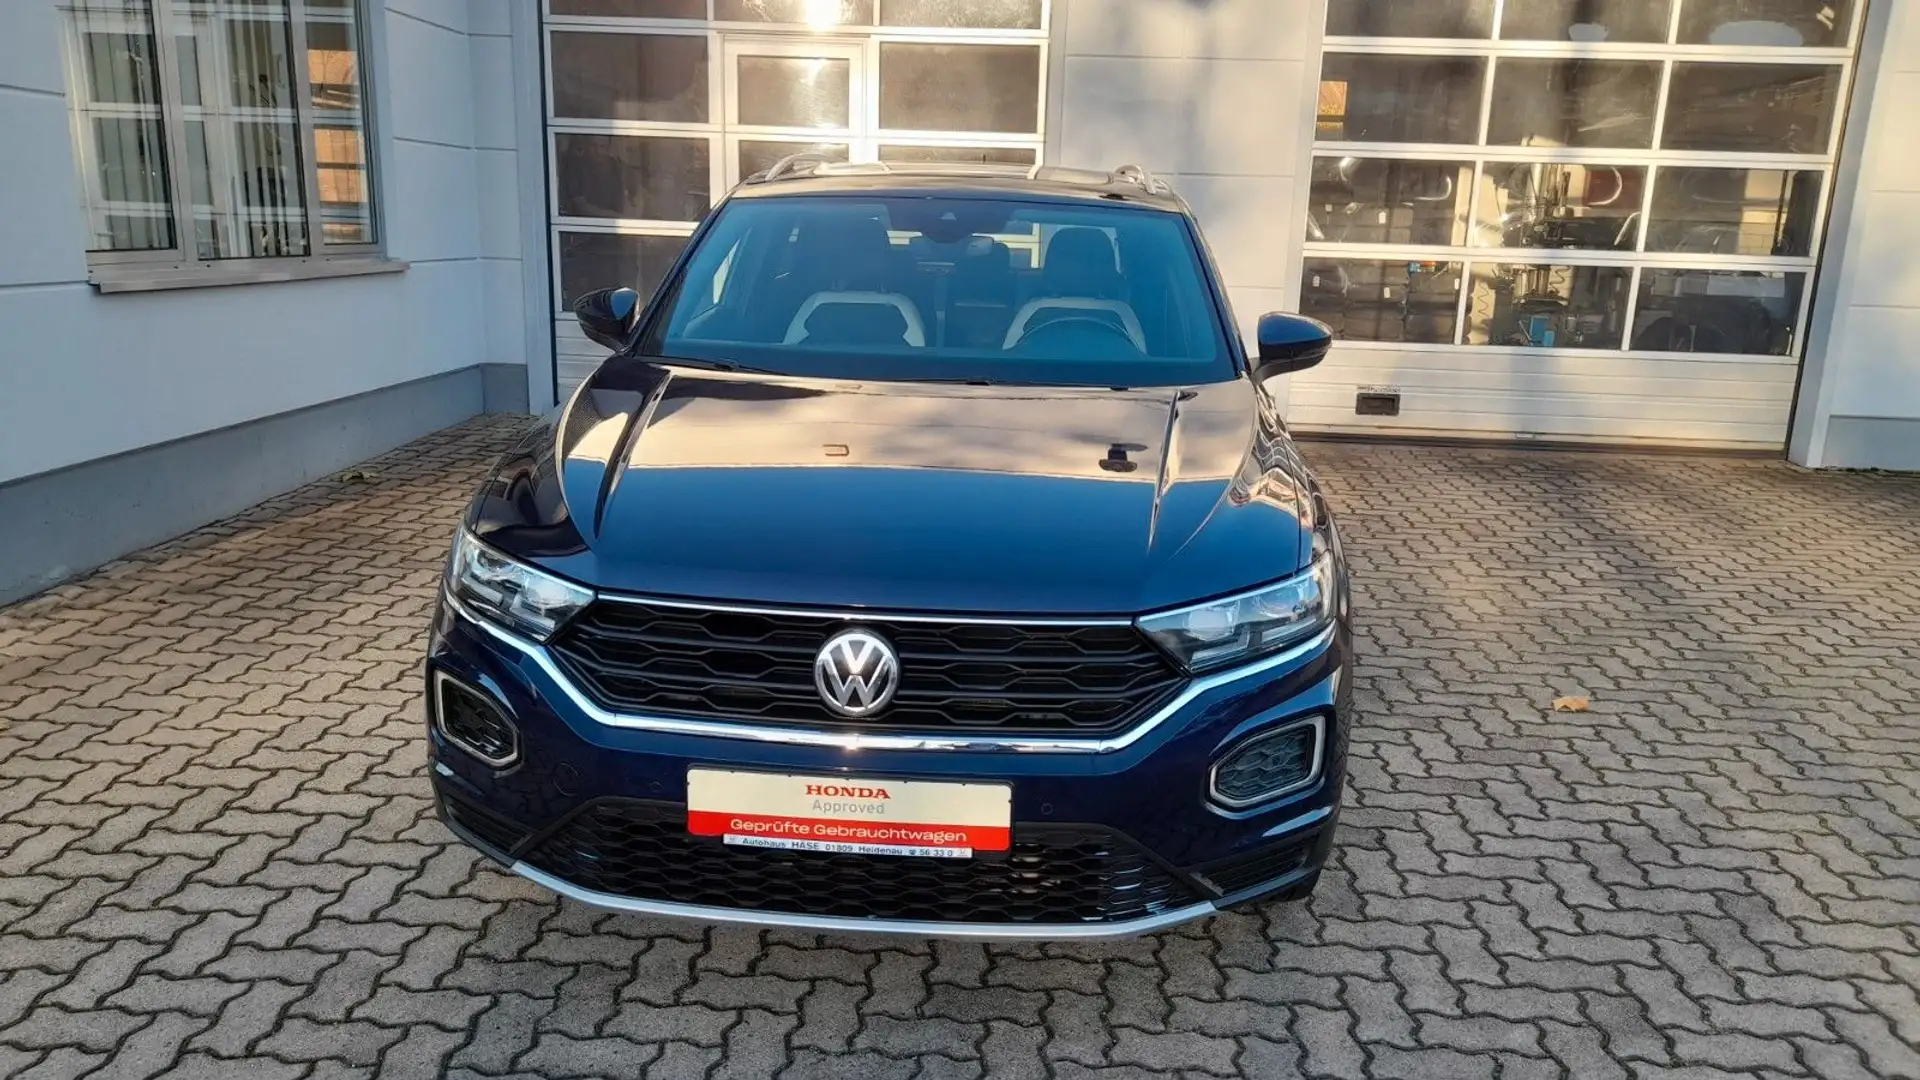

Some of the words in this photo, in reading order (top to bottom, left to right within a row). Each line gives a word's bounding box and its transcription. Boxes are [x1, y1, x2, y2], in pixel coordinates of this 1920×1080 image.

[818, 634, 895, 712] VW
[806, 784, 891, 799] HONDA
[812, 799, 885, 814] Approved
[730, 818, 810, 834] Geprüfte
[813, 824, 967, 844] Gebrauchtwagen
[742, 837, 787, 849] Autohaus
[825, 843, 854, 852] 01809
[858, 845, 903, 855] Heidenau
